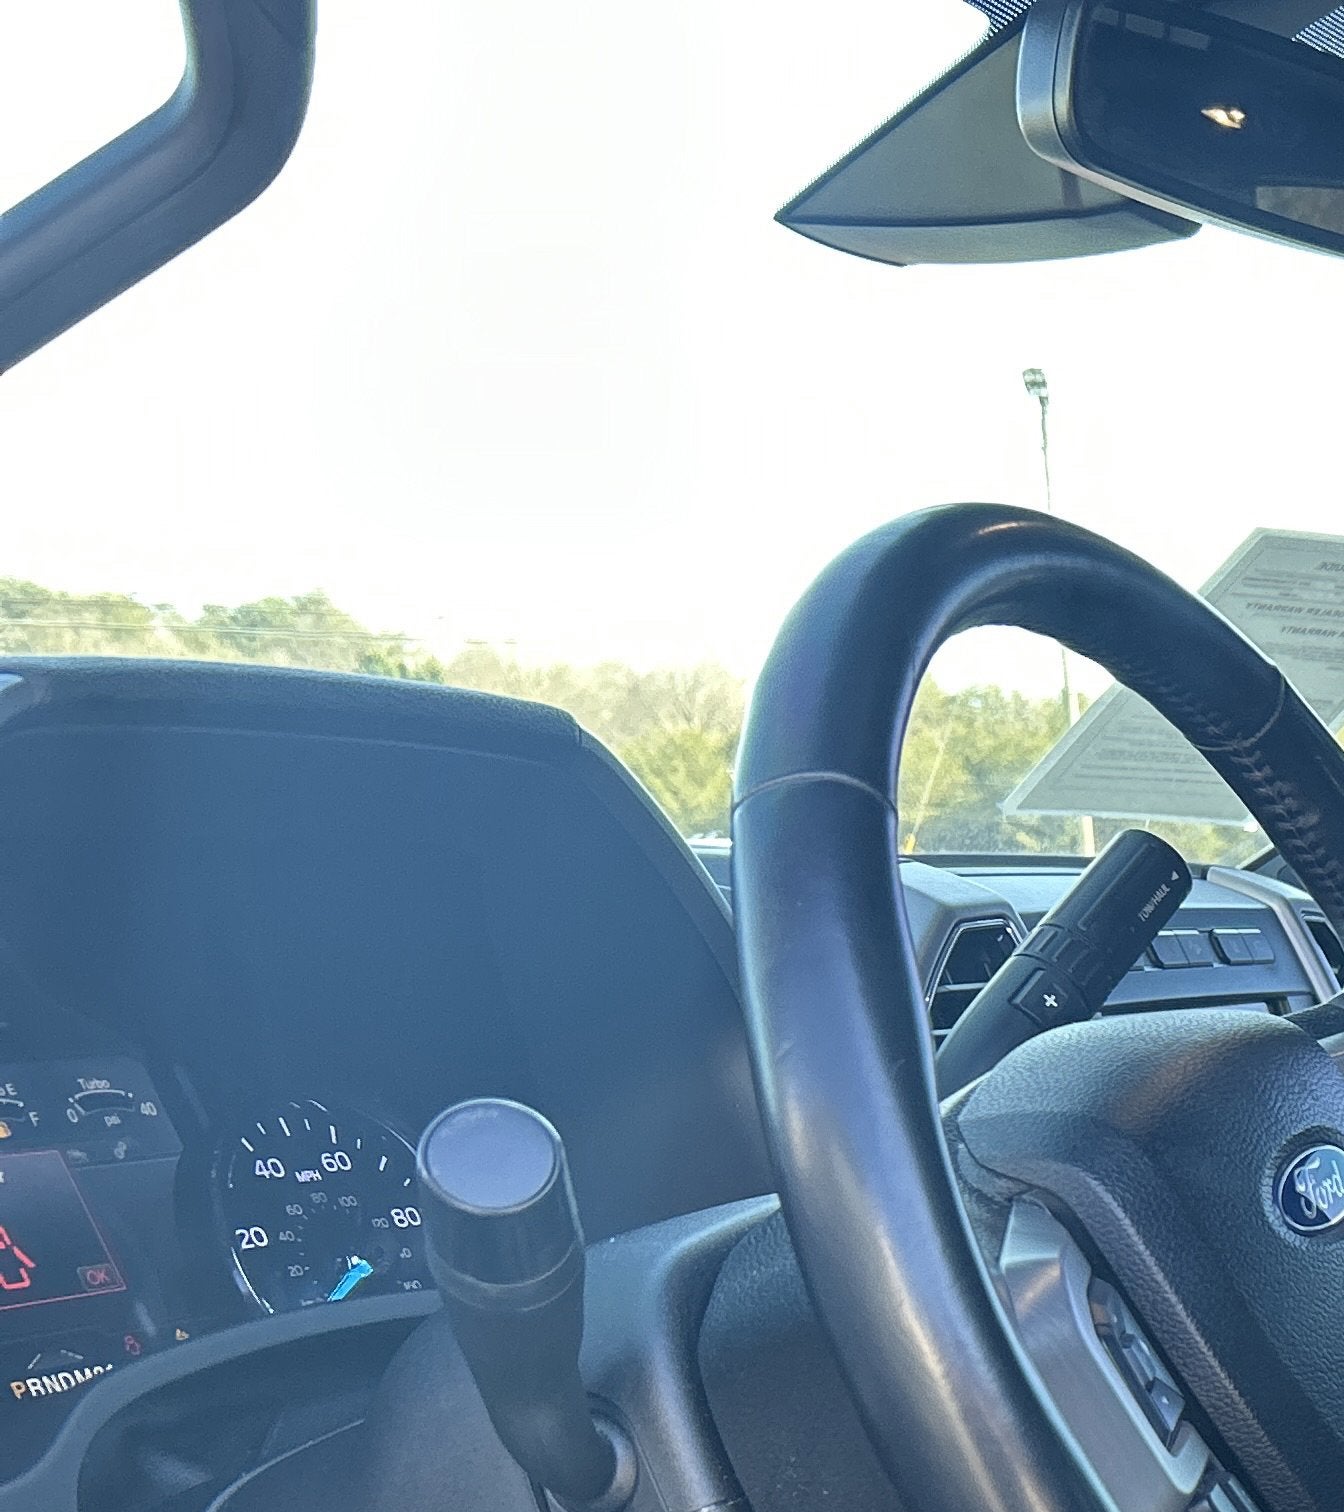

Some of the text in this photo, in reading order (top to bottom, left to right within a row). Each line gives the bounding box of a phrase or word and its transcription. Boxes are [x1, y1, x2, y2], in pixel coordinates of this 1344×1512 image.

[77, 1078, 111, 1090] Turbo
[254, 1158, 285, 1178] 40
[321, 1151, 352, 1172] 60
[295, 1169, 322, 1183] MPH
[286, 1204, 303, 1216] 60
[390, 1206, 421, 1228] 80
[235, 1226, 269, 1249] 20
[279, 1230, 295, 1241] 40
[86, 1269, 109, 1285] OK
